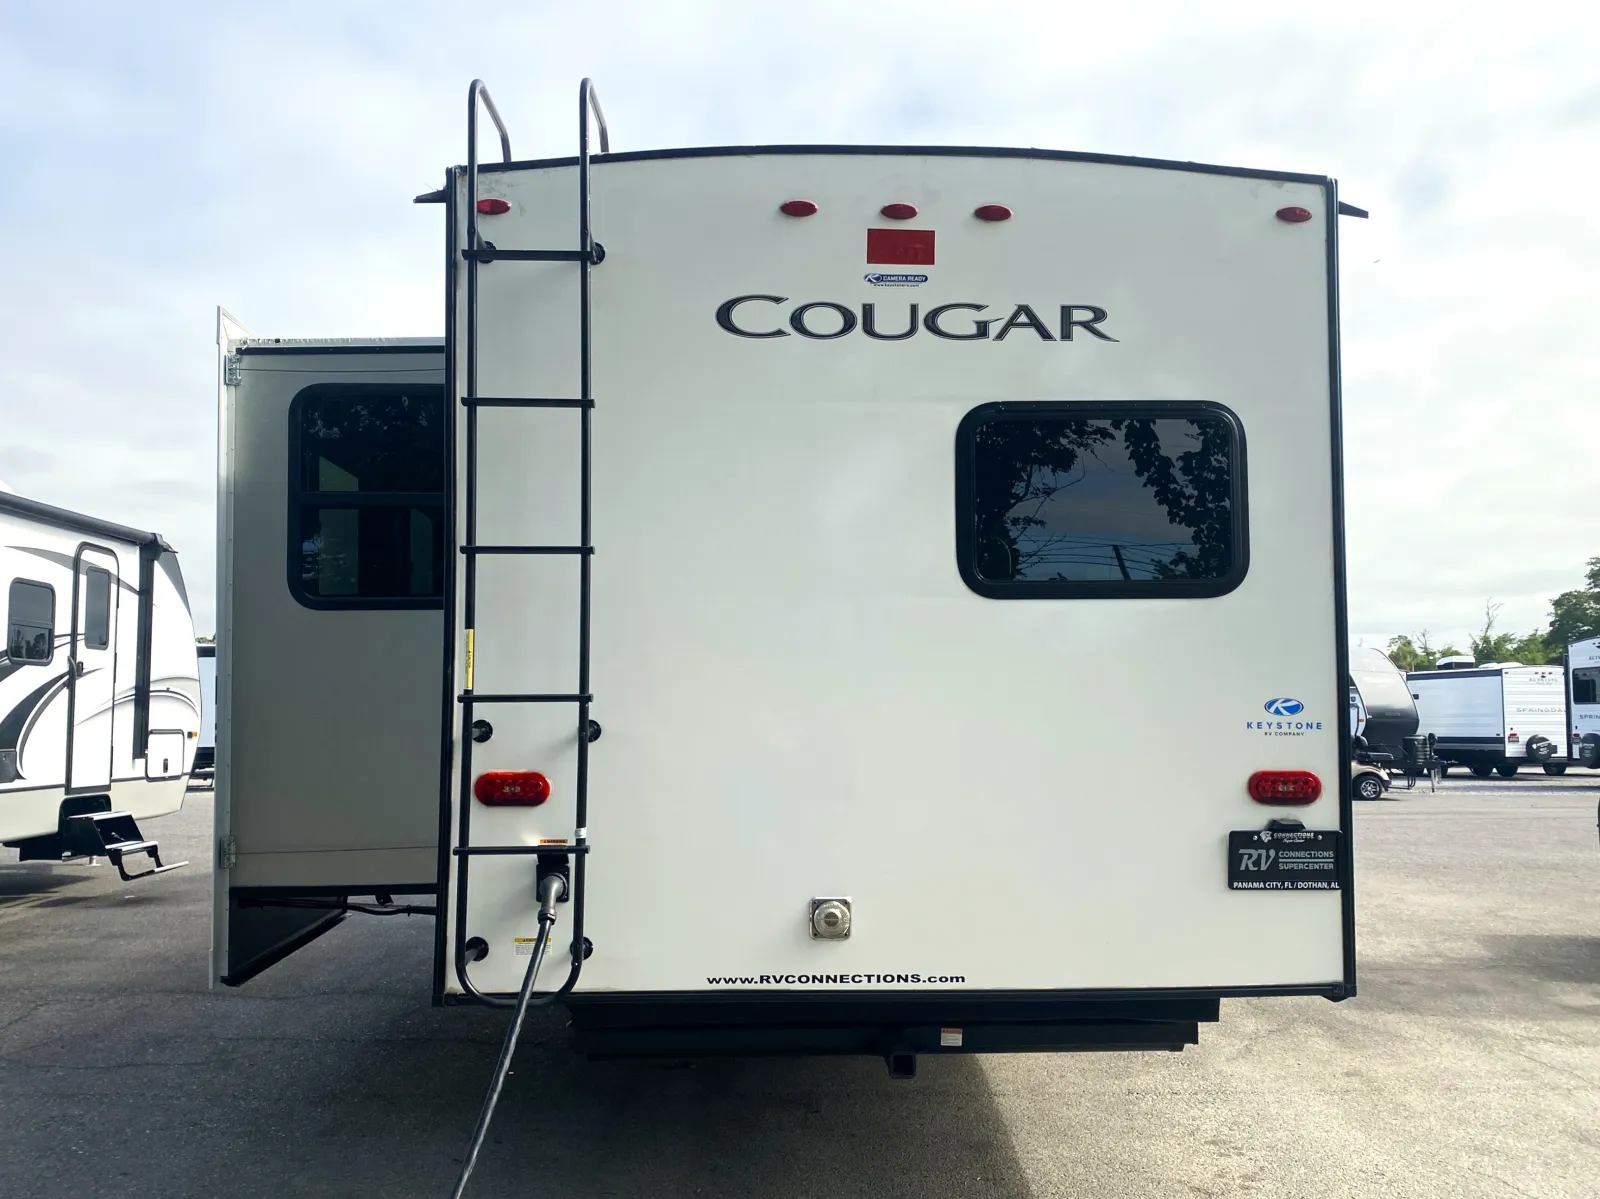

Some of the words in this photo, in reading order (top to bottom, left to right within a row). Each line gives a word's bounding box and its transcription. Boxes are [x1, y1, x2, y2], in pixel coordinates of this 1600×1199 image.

[715, 293, 1120, 343] COUGAR
[1246, 721, 1322, 730] KEYSTONE
[1238, 848, 1276, 871] RV
[1233, 881, 1264, 889] PANAMA
[1265, 881, 1283, 890] CITY,
[1284, 881, 1293, 889] FL
[1297, 881, 1329, 890] DOTHAN,
[1330, 881, 1340, 889] AL
[706, 973, 966, 985] www.RVCONNECTIONS.com
